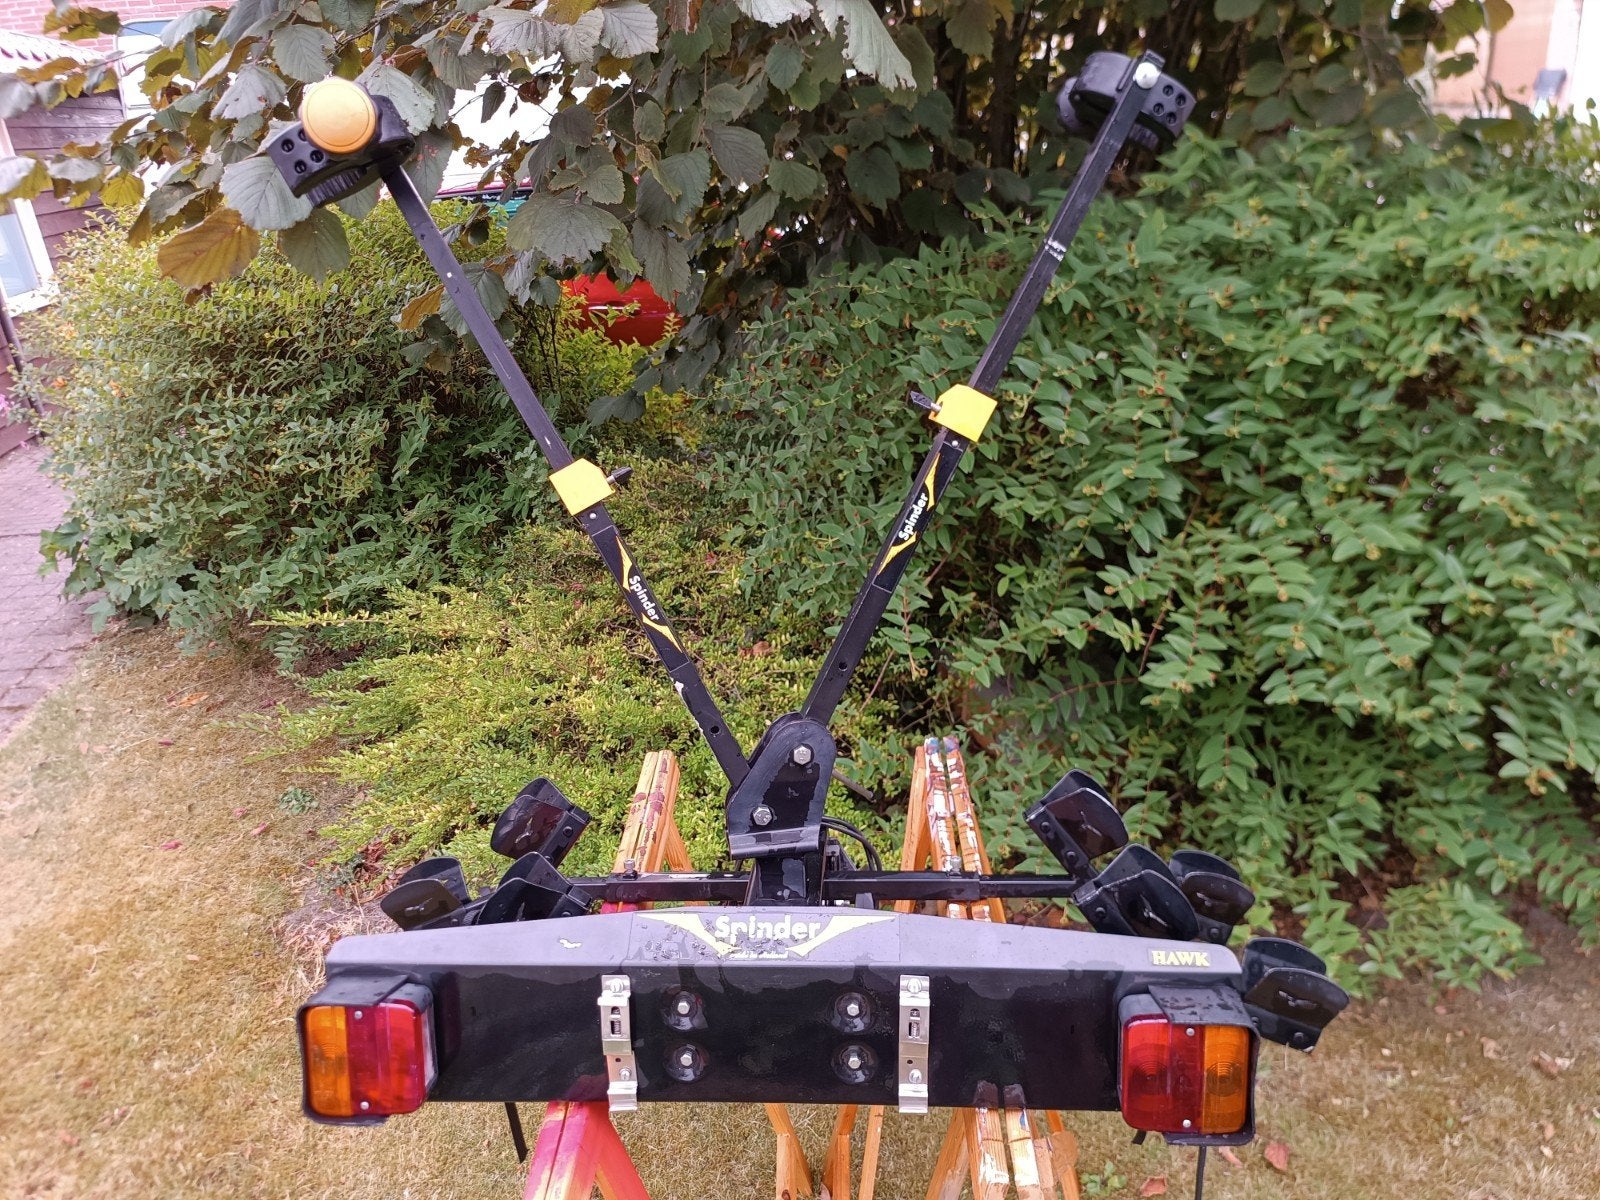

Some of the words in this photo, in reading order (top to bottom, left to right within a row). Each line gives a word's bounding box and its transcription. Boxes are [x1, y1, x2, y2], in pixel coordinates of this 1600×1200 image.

[898, 492, 928, 541] Spinder
[629, 575, 660, 620] Spinder
[714, 913, 821, 945] Spinder
[1151, 950, 1210, 967] HAWK
